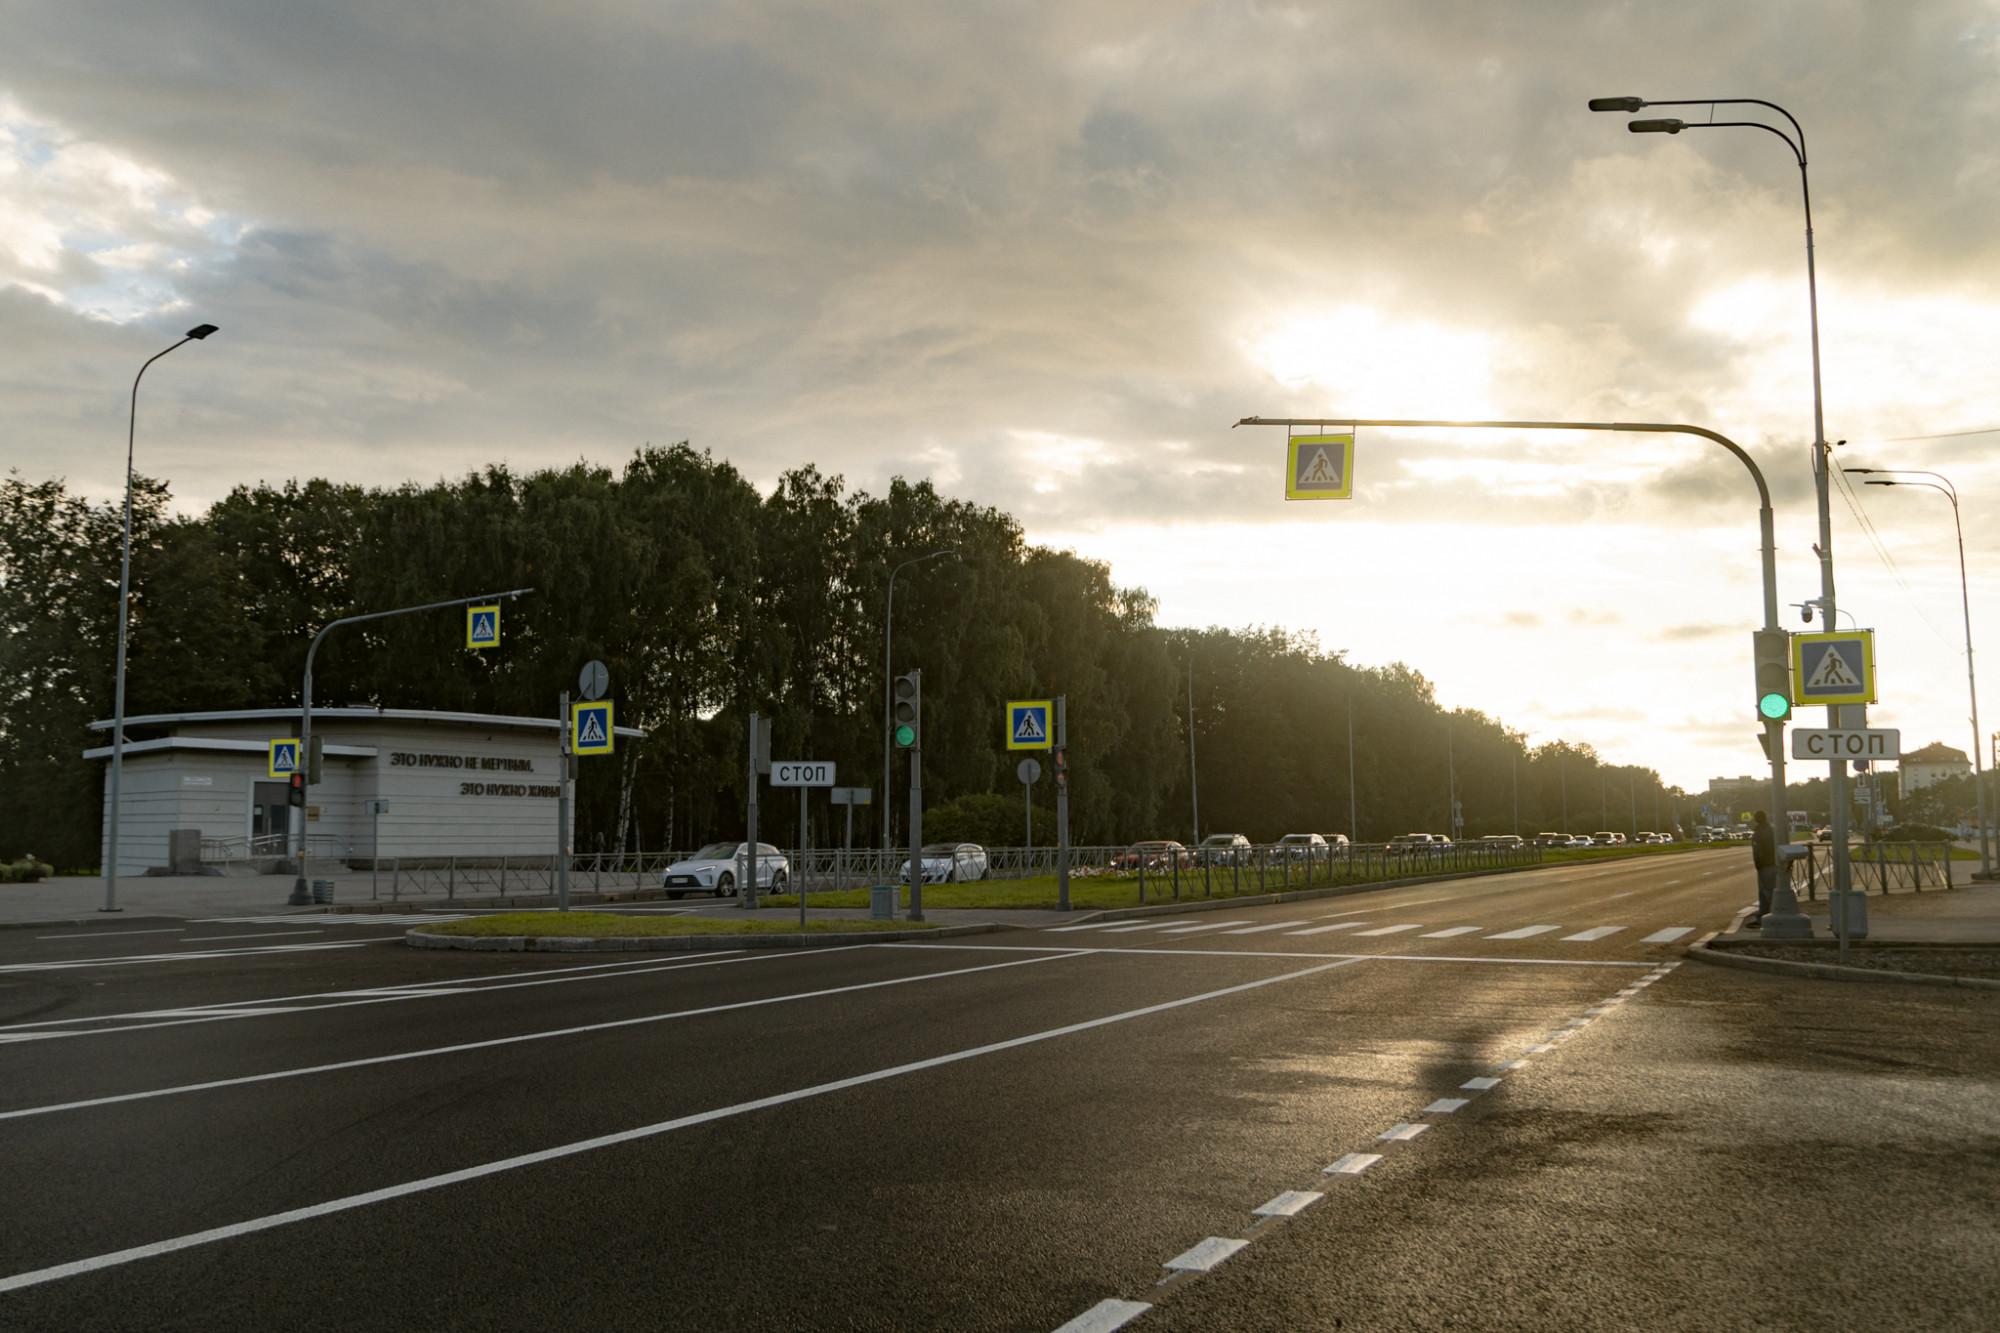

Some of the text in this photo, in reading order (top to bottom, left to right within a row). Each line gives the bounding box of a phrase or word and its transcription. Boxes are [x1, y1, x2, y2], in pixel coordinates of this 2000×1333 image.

[1808, 734, 1884, 754] СТОП
[391, 752, 416, 766] ЭТО
[419, 754, 463, 769] НУЖНО
[465, 757, 480, 770] НЕ
[780, 766, 825, 782] СТОП
[460, 782, 484, 796] ЭТО
[486, 784, 526, 797] НУЖНО
